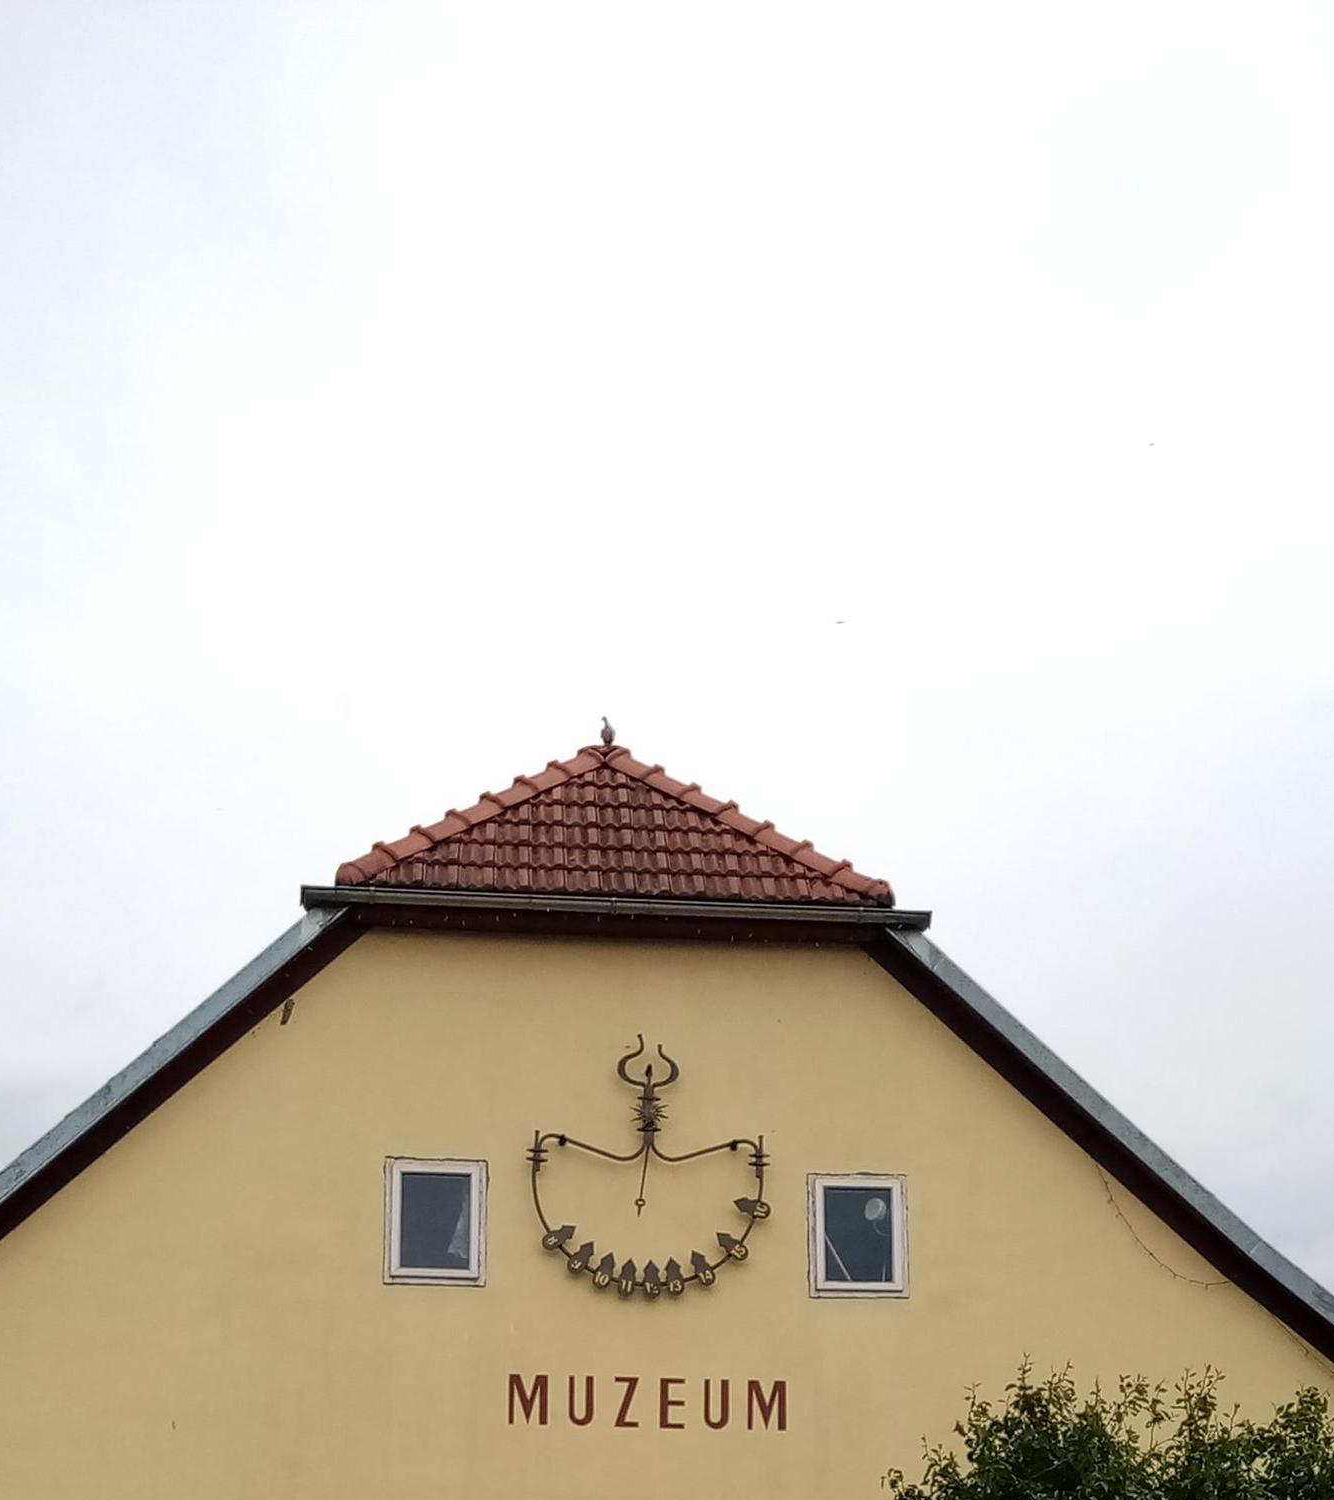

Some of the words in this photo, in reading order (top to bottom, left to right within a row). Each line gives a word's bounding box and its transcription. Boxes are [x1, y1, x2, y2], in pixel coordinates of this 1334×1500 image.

[593, 1271, 610, 1287] 10
[620, 1279, 633, 1292] 11
[669, 1279, 682, 1292] 13
[699, 1269, 713, 1283] 14
[730, 1243, 746, 1259] 15
[507, 1373, 787, 1432] MUZEUM
